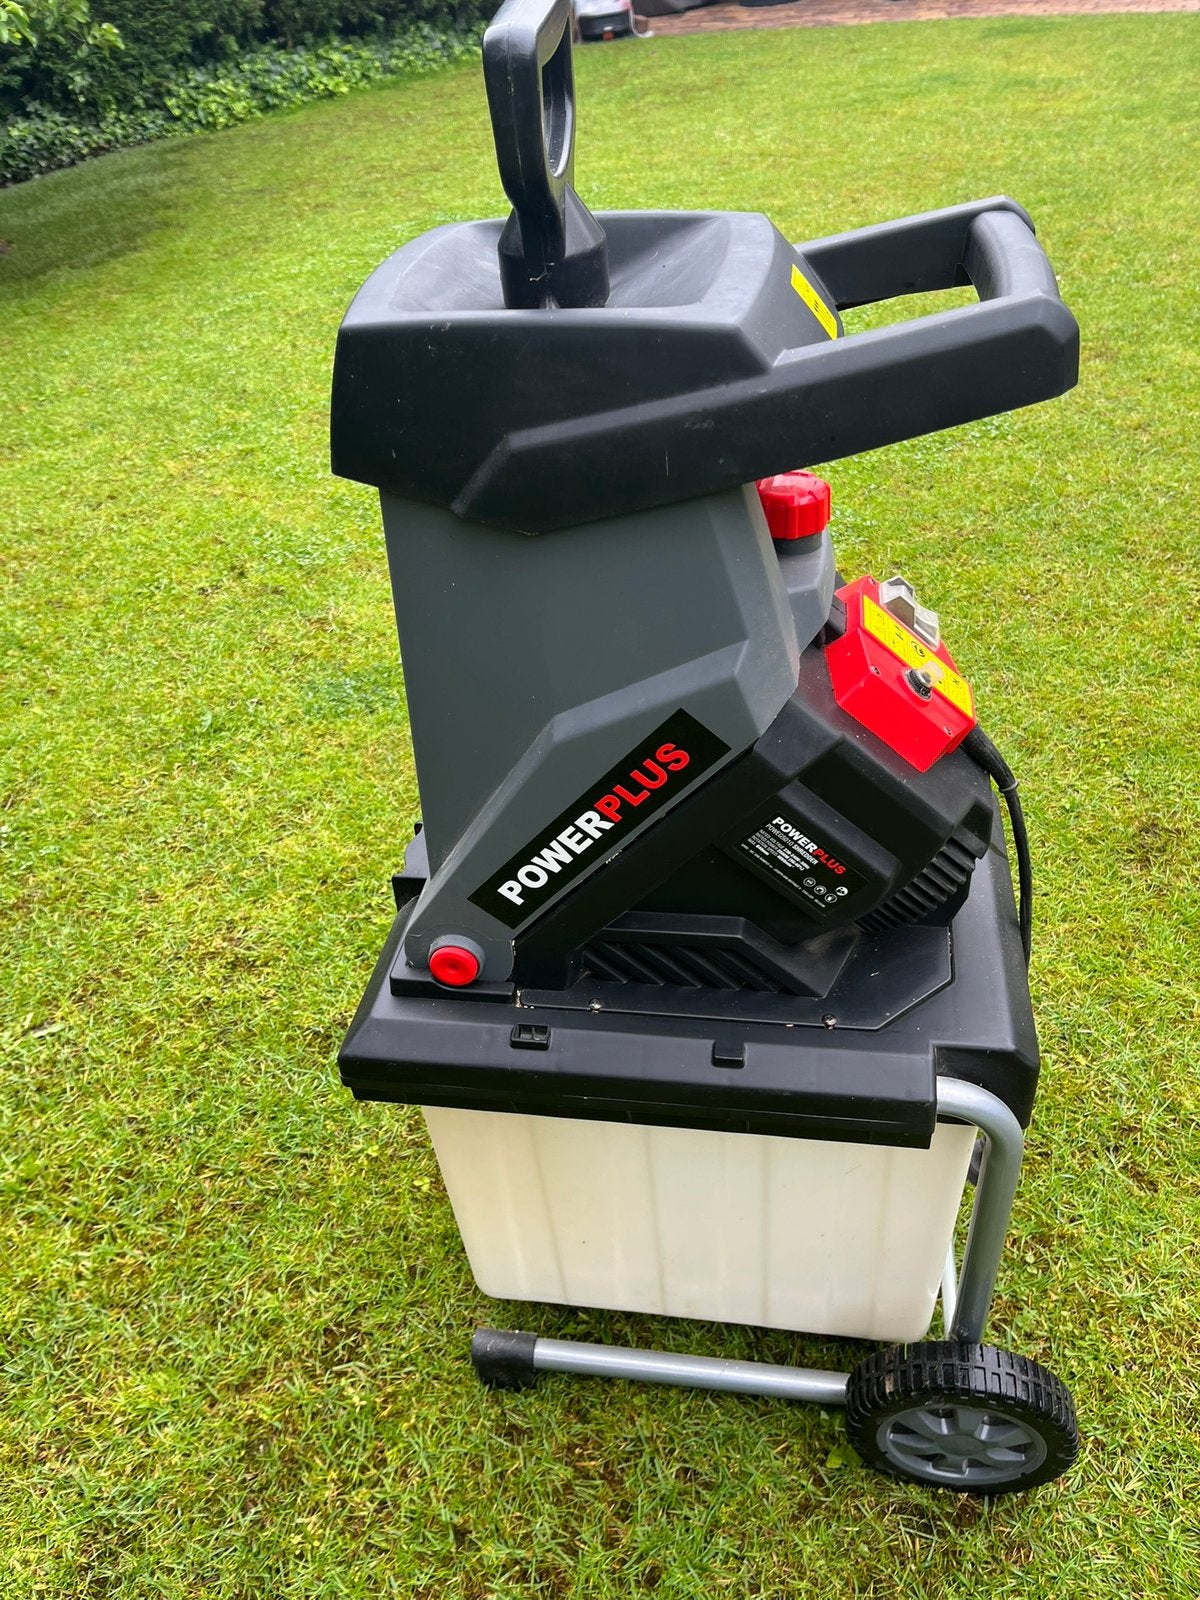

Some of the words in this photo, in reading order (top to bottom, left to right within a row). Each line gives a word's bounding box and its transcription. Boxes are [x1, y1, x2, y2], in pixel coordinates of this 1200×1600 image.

[497, 743, 690, 906] POWERPLUS
[772, 817, 846, 875] POWERPLUS
[792, 844, 818, 865] SHREDDER
